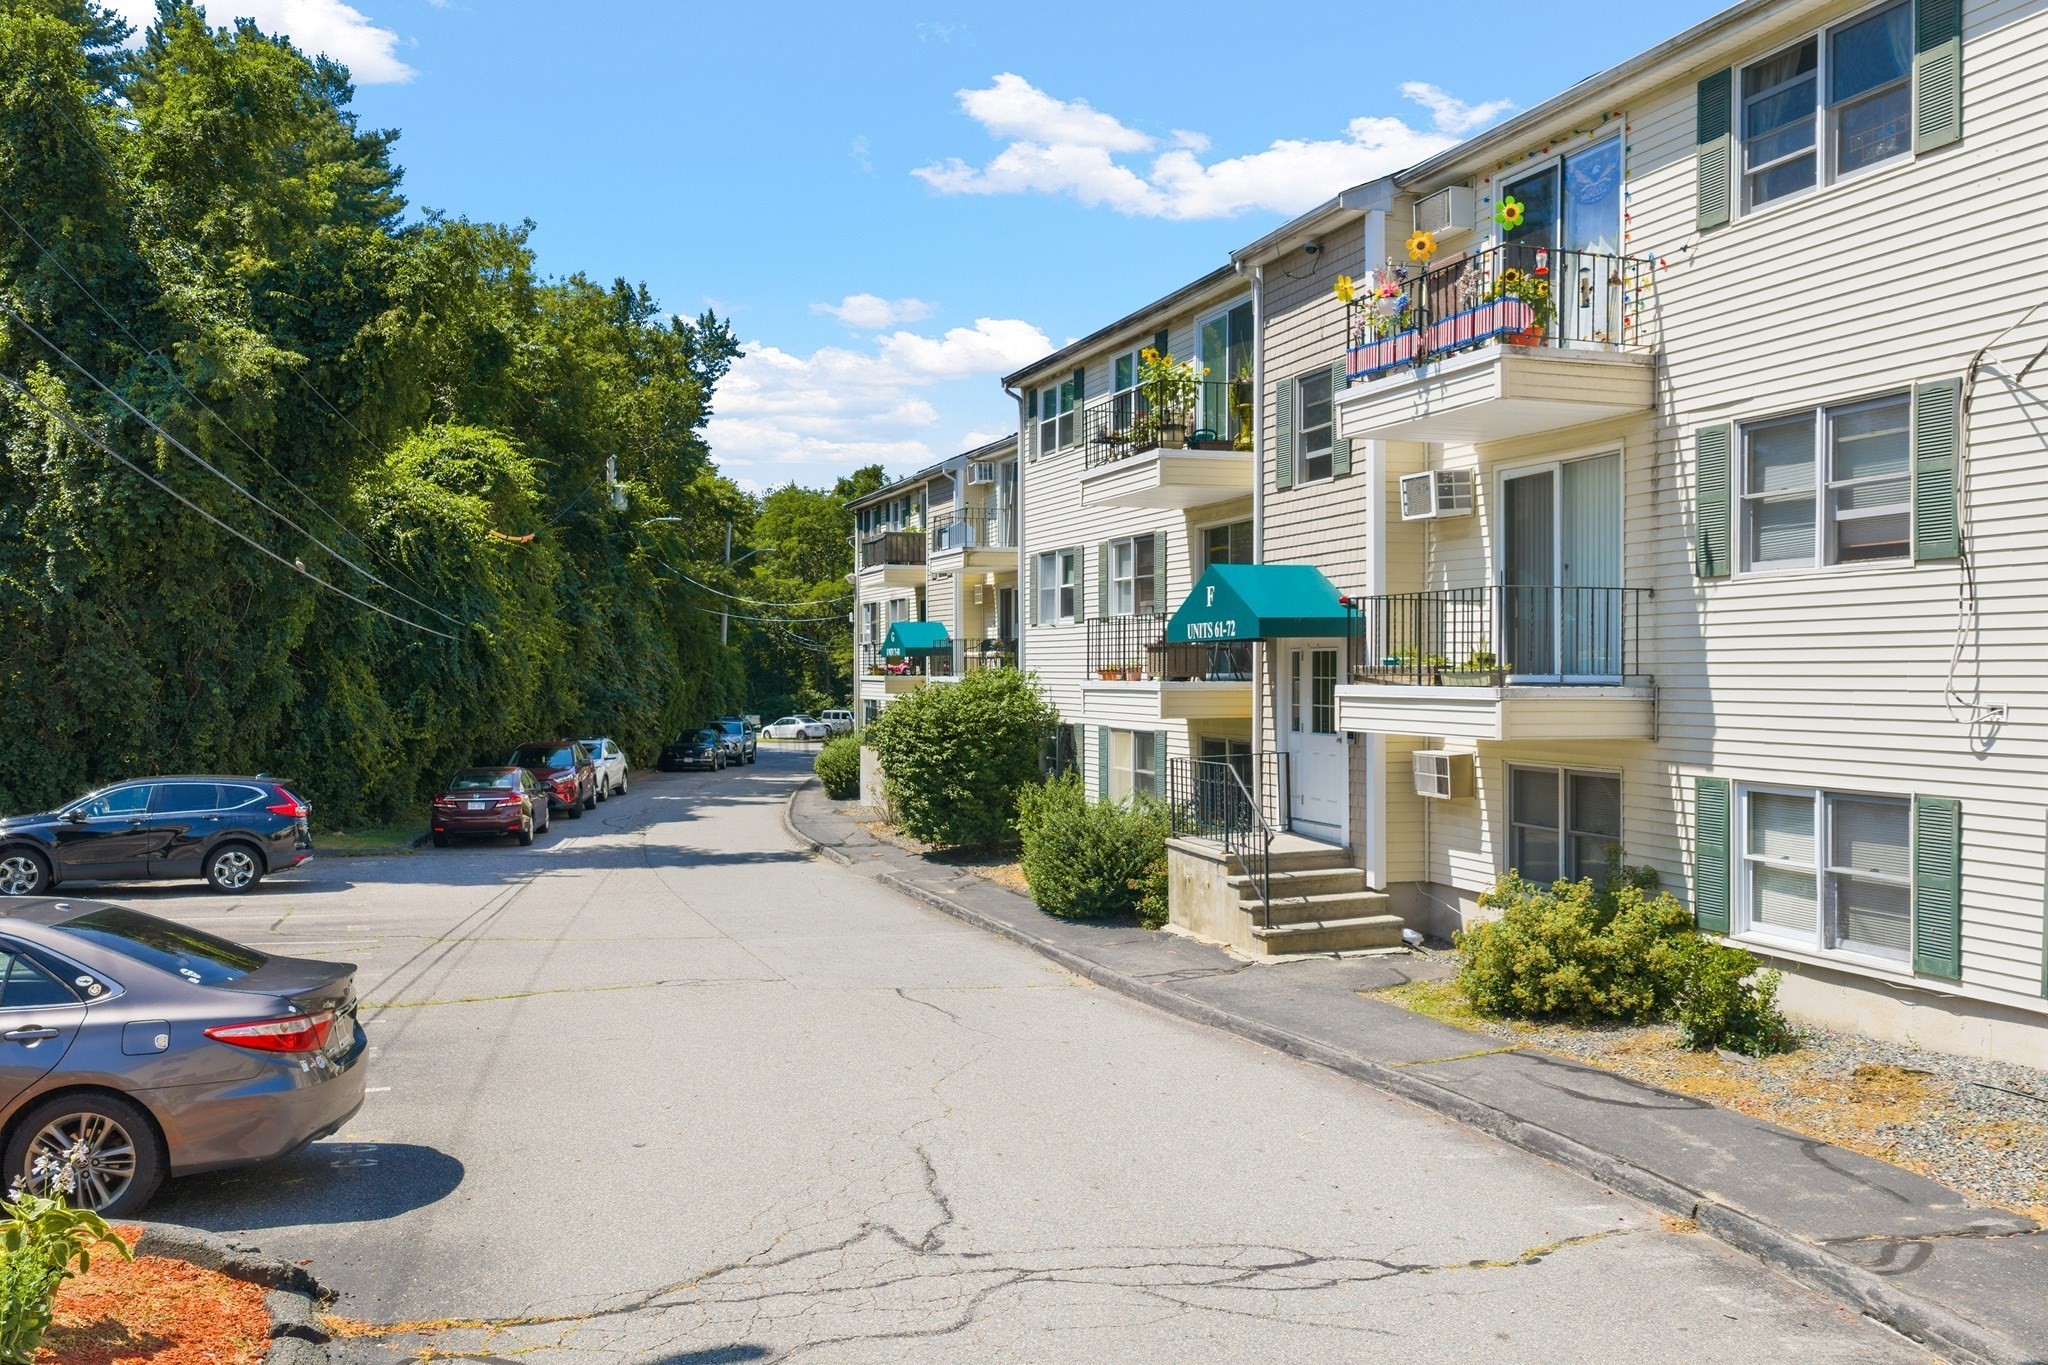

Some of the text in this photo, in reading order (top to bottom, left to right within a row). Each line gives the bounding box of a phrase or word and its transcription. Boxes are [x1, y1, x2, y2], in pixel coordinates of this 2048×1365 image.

[1206, 586, 1215, 607] F
[1187, 620, 1236, 640] UNITS 61-72
